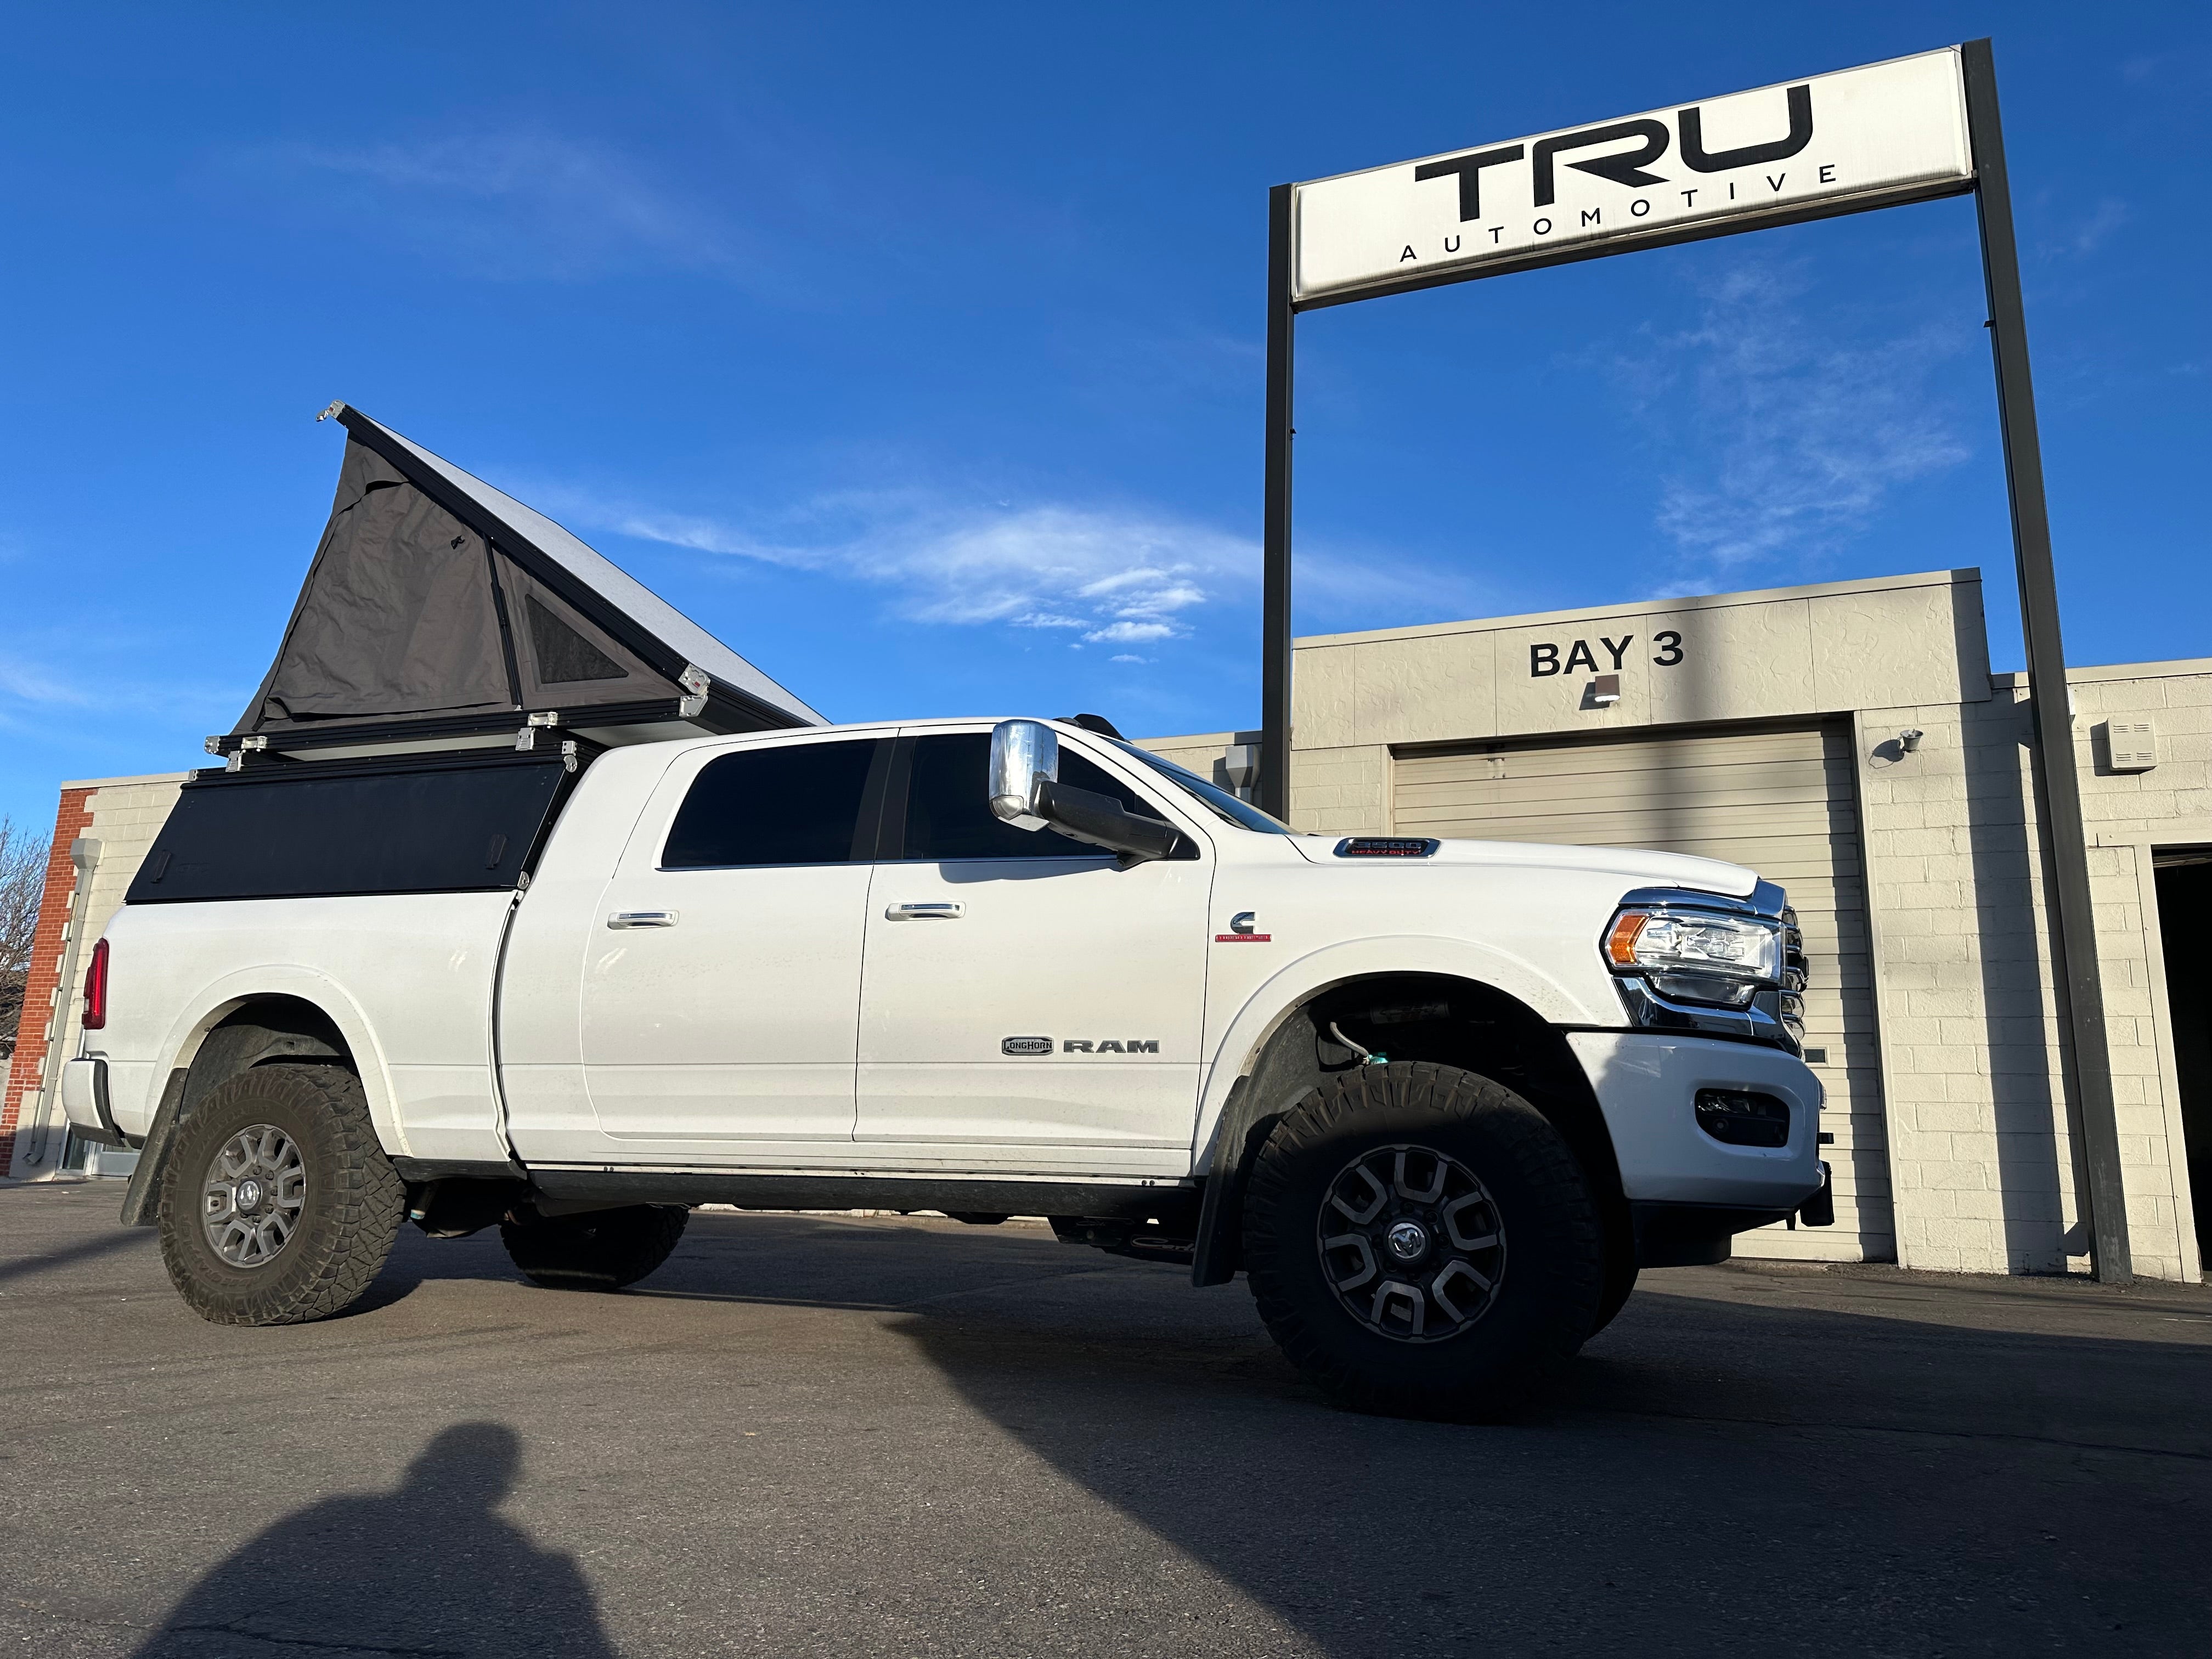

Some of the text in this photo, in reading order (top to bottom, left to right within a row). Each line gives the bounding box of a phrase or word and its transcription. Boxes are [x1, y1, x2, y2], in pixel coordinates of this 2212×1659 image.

[1415, 84, 1813, 223] TRU
[1400, 164, 1836, 262] AUTOMOTIVE
[1530, 630, 1684, 678] BAY 3
[1003, 1040, 1160, 1053] LONGHORN RAM
